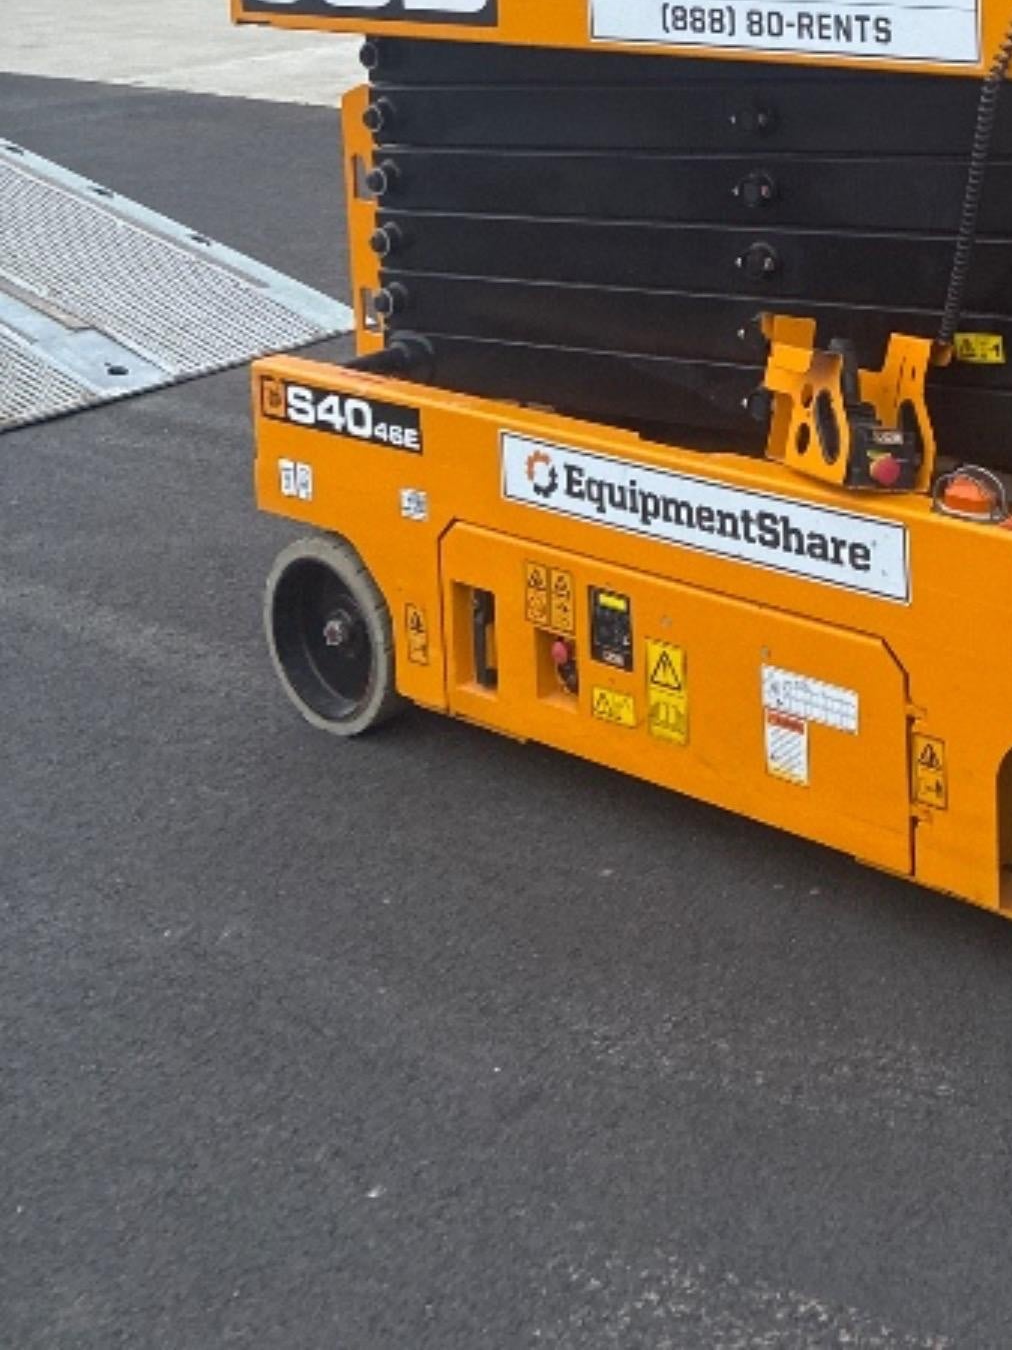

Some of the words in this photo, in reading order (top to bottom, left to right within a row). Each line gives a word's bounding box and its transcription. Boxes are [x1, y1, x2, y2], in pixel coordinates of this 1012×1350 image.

[662, 2, 736, 37] (888)
[746, 9, 892, 44] 80-RENTS
[564, 463, 871, 571] EquipmentShare
